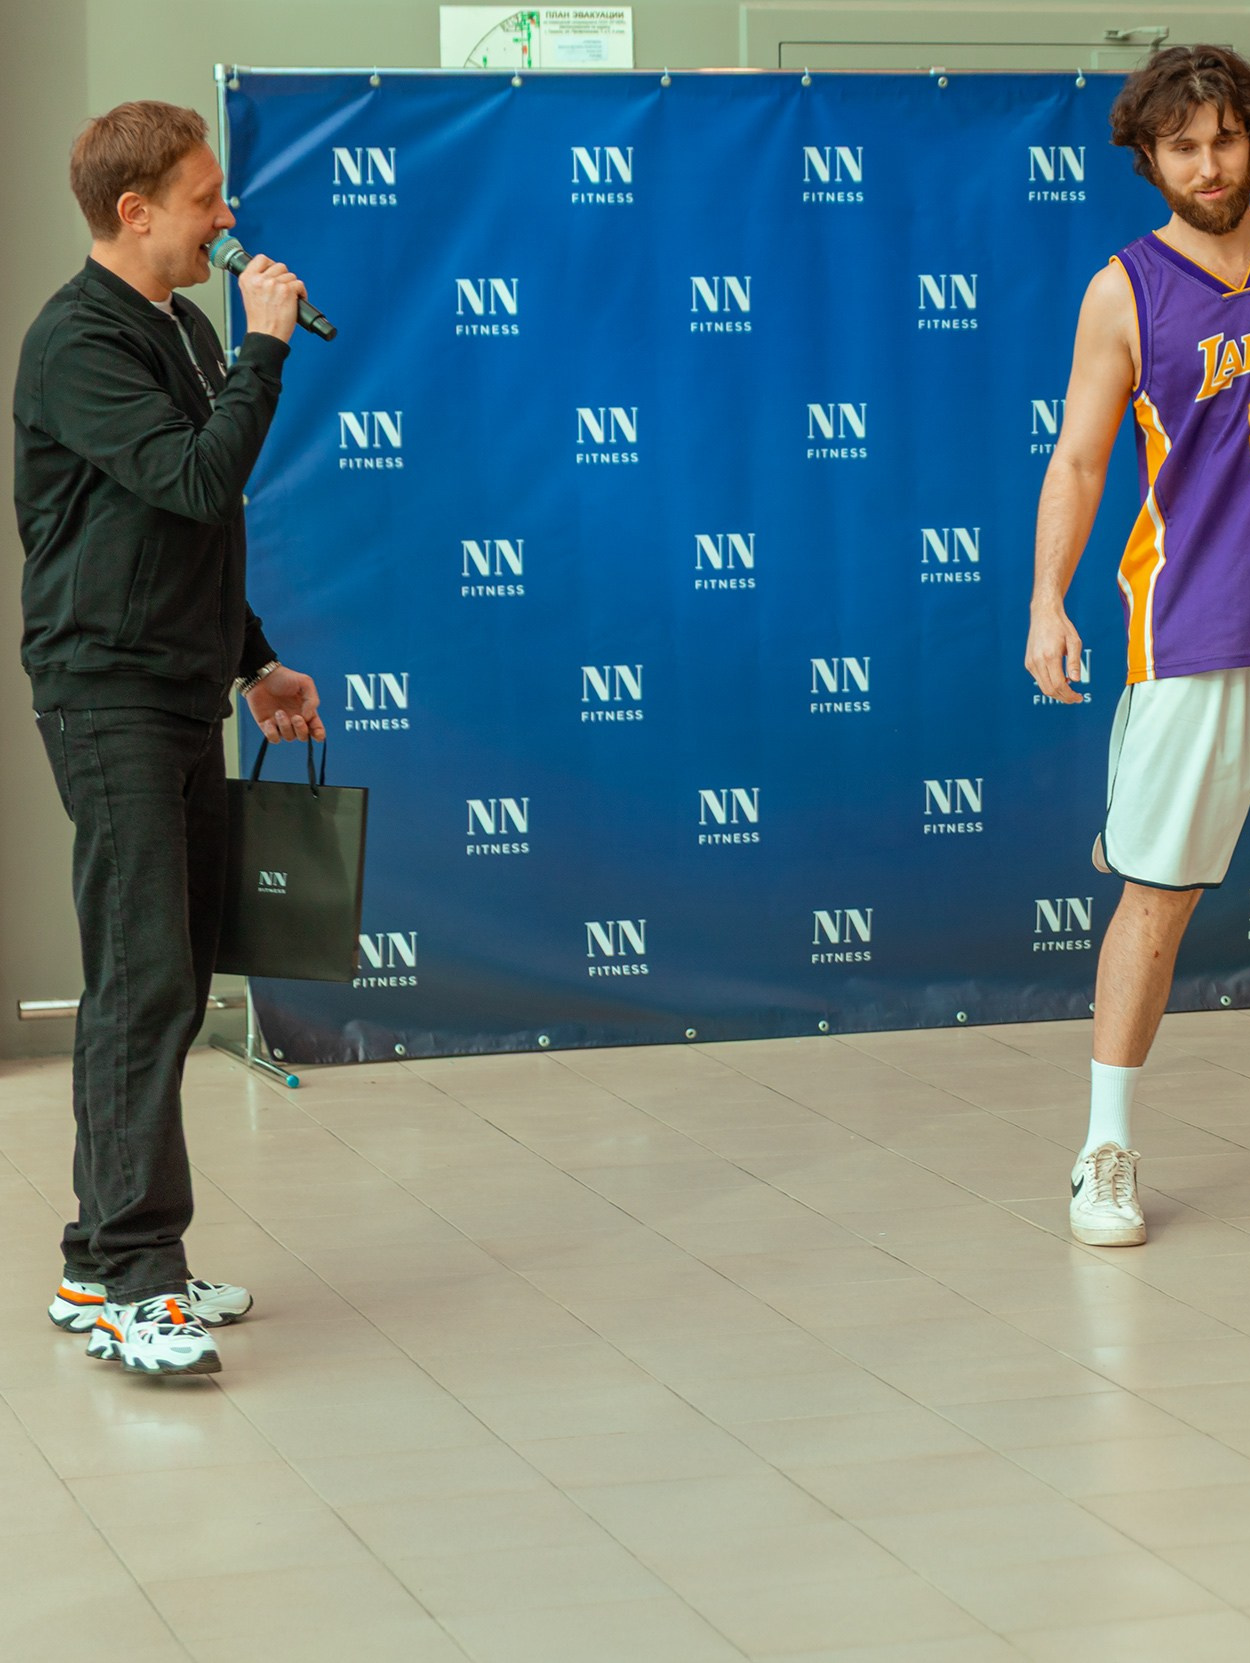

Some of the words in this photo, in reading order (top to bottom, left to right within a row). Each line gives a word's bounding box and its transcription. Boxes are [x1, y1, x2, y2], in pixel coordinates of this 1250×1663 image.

[545, 11, 570, 19] ПЛАН
[572, 11, 625, 20] ЭВАКУАЦИИ
[332, 147, 396, 186] NN
[571, 146, 634, 184] NN
[803, 145, 864, 183] NN
[1028, 146, 1086, 182] NN
[332, 193, 397, 205] FITNESS
[571, 192, 634, 204] FITNESS
[803, 191, 864, 202] FITNESS
[1028, 190, 1086, 201] FITNESS
[455, 278, 518, 316] NN
[690, 275, 752, 313] NN
[918, 274, 978, 310] NN
[455, 324, 519, 335] FITNESS
[690, 321, 752, 332] FITNESS
[918, 318, 978, 329] FITNESS
[576, 406, 638, 444] NN
[807, 402, 867, 439] NN
[1030, 399, 1066, 435] N
[338, 410, 402, 449] NN
[576, 452, 639, 464] FITNESS
[807, 447, 867, 459] FITNESS
[339, 456, 404, 469] FITNESS
[694, 532, 756, 570] NN
[921, 527, 981, 564] NN
[461, 538, 524, 577] NN
[694, 578, 756, 590] FITNESS
[920, 571, 981, 583] FITNESS
[461, 584, 525, 597] FITNESS
[581, 664, 643, 702] NN
[810, 656, 871, 694] NN
[344, 672, 409, 711] NN
[581, 709, 644, 722] FITNESS
[810, 701, 871, 714] FITNESS
[345, 718, 410, 731] FITNESS
[923, 777, 984, 815] NN
[698, 787, 760, 826] NN
[466, 797, 529, 836] NN
[923, 821, 984, 835] FITNESS
[698, 831, 760, 845] FITNESS
[466, 842, 529, 856] FITNESS
[258, 870, 288, 887] NN
[1034, 896, 1094, 934] NN
[812, 907, 873, 945] NN
[584, 919, 646, 958] NN
[1032, 939, 1092, 953] FITNESS
[357, 931, 418, 969] NN
[811, 950, 872, 964] FITNESS
[588, 963, 649, 977] FITNESS
[352, 975, 418, 989] FITNESS
